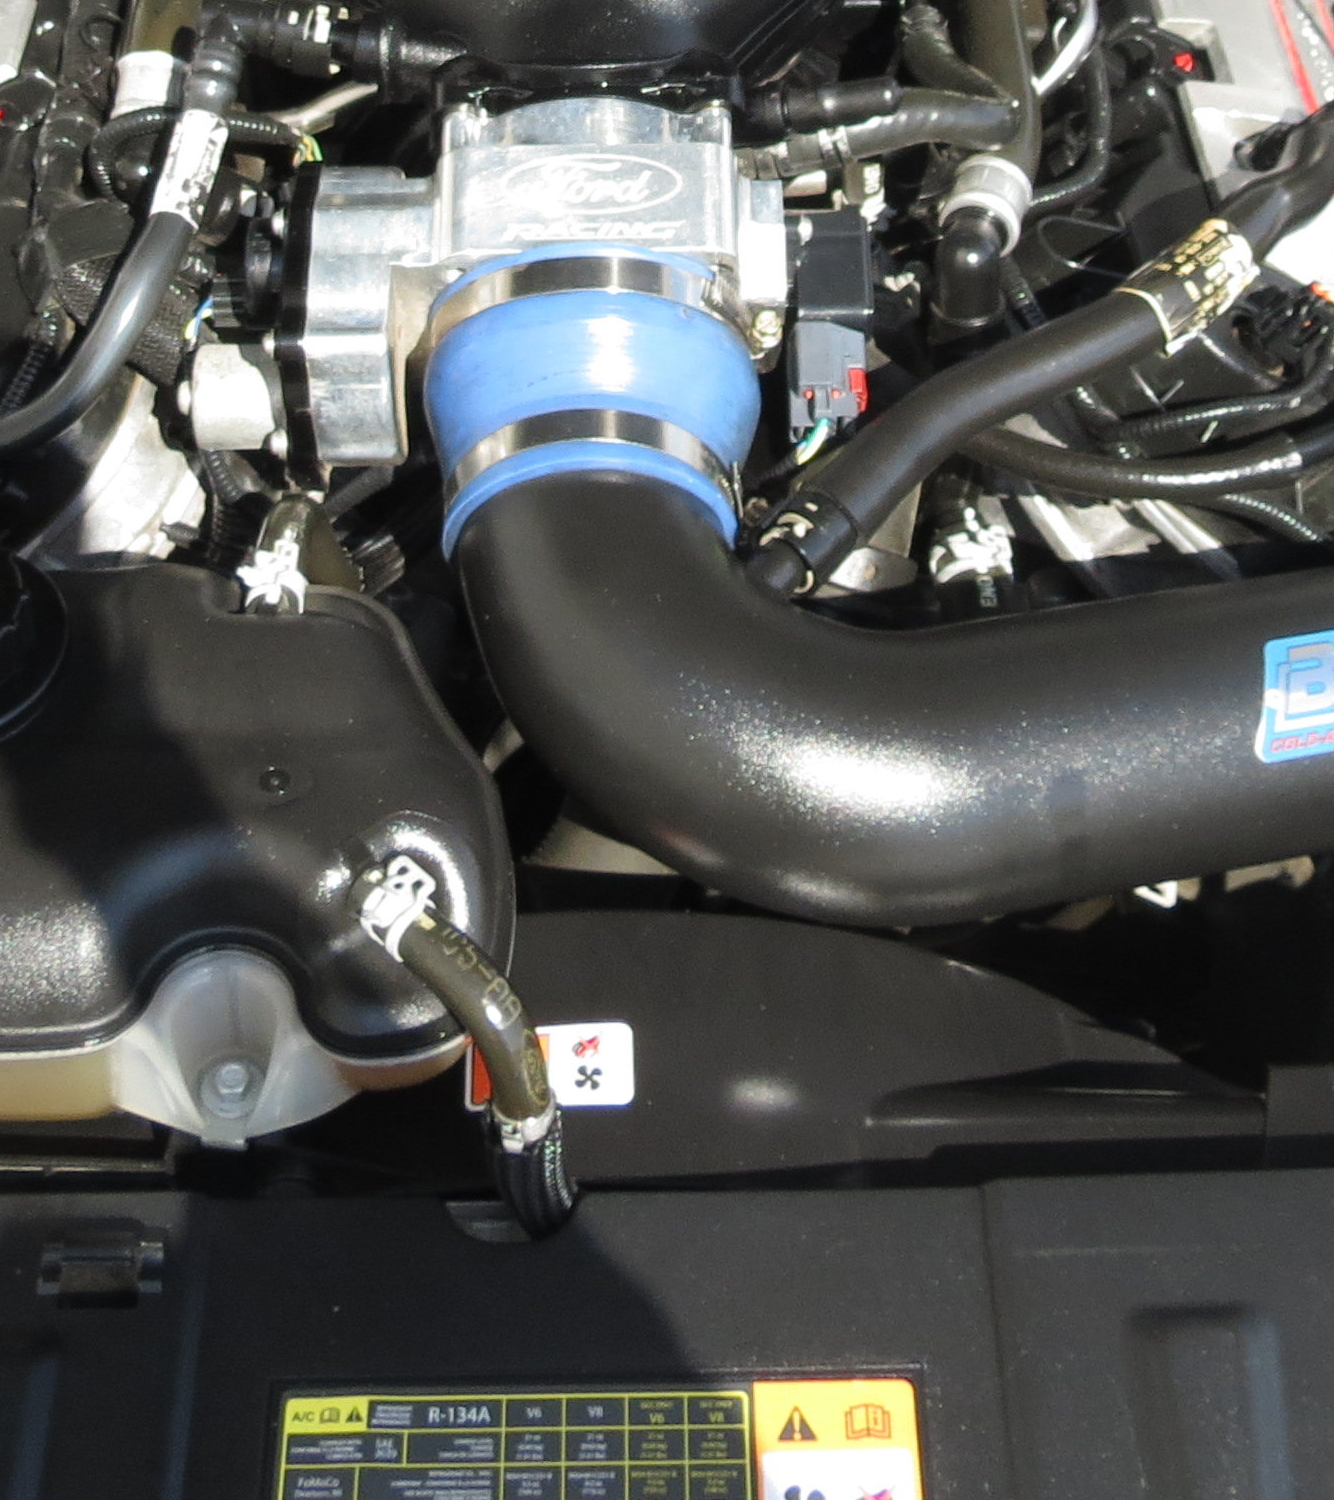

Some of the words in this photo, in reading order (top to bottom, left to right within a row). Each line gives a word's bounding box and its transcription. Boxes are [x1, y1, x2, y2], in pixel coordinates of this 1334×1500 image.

[517, 161, 654, 208] Ford
[500, 220, 686, 242] RACING
[292, 1411, 316, 1422] A/C
[428, 1406, 491, 1424] R-134A
